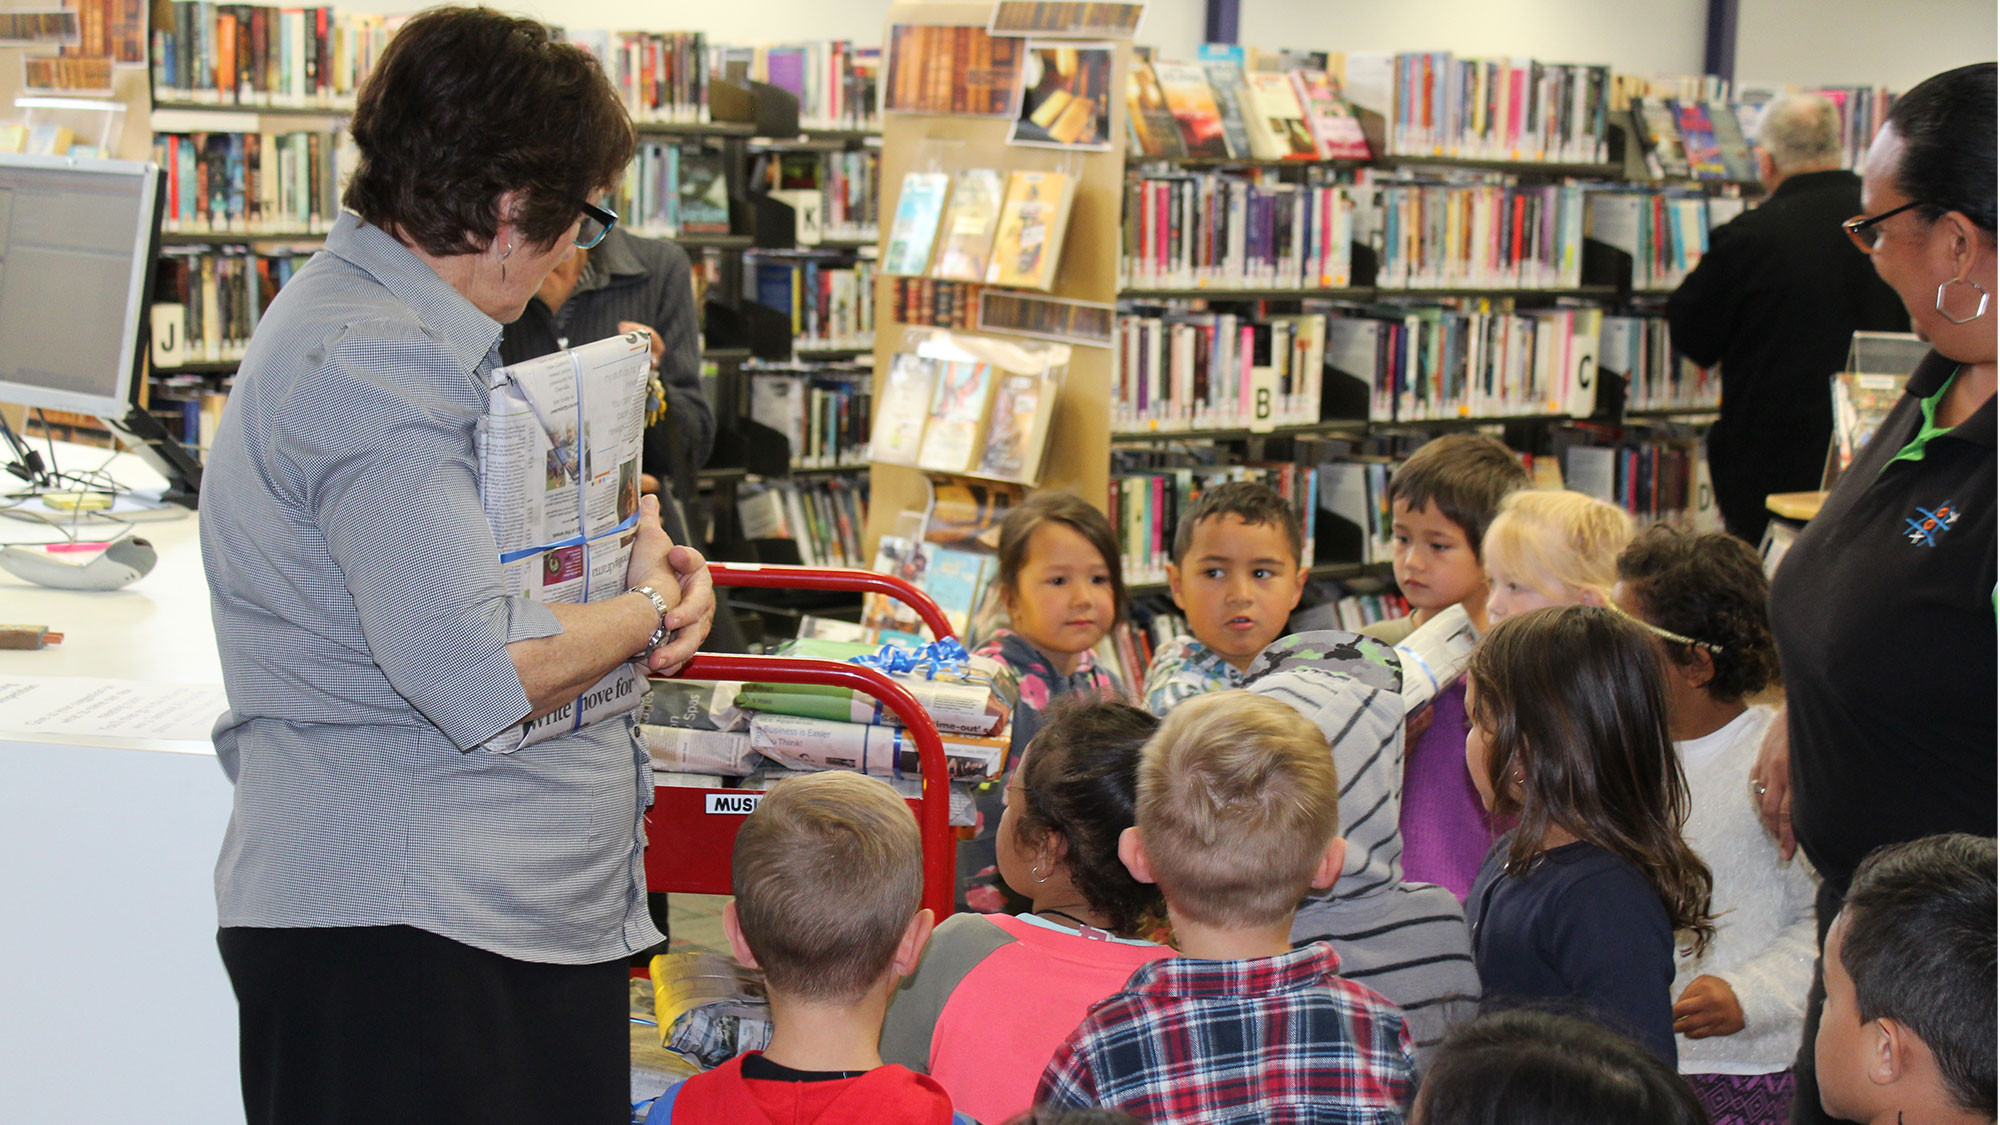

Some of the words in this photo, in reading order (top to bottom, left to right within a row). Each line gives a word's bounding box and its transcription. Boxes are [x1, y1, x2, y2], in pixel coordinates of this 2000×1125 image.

[804, 206, 817, 231] K
[161, 322, 175, 352] J
[1579, 354, 1592, 390] C
[1256, 387, 1271, 420] B
[1699, 483, 1712, 512] D
[582, 687, 613, 712] ove
[615, 677, 635, 699] for
[683, 694, 700, 720] Spas
[807, 729, 832, 738] Easier
[714, 797, 758, 812] MUSI
